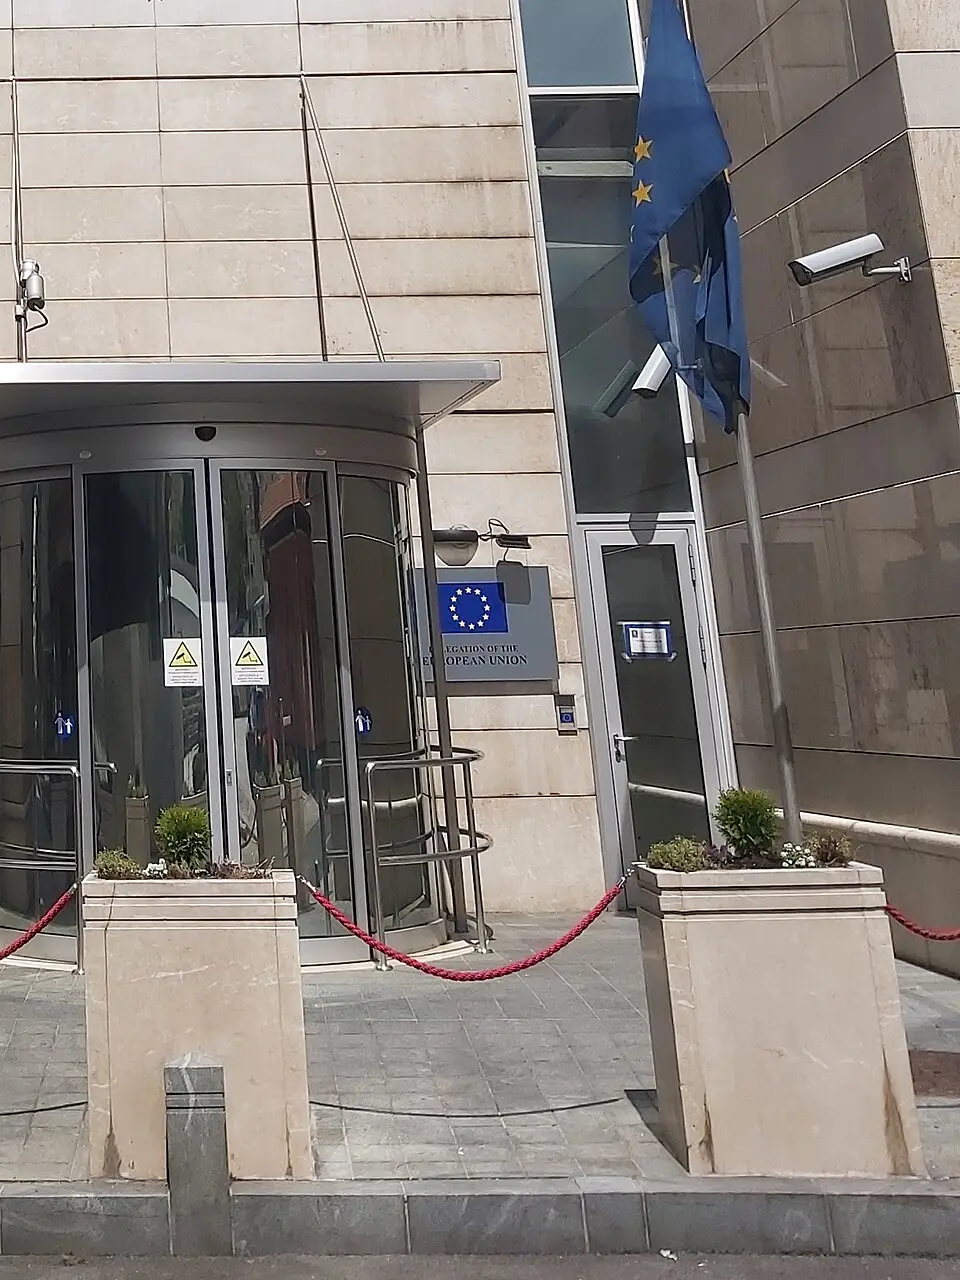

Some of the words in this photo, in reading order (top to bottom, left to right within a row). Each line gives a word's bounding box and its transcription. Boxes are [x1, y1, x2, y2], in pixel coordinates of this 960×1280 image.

[487, 645, 499, 653] OF
[500, 644, 519, 653] THE
[422, 655, 486, 666] EOPEAN
[488, 655, 528, 665] UNION
